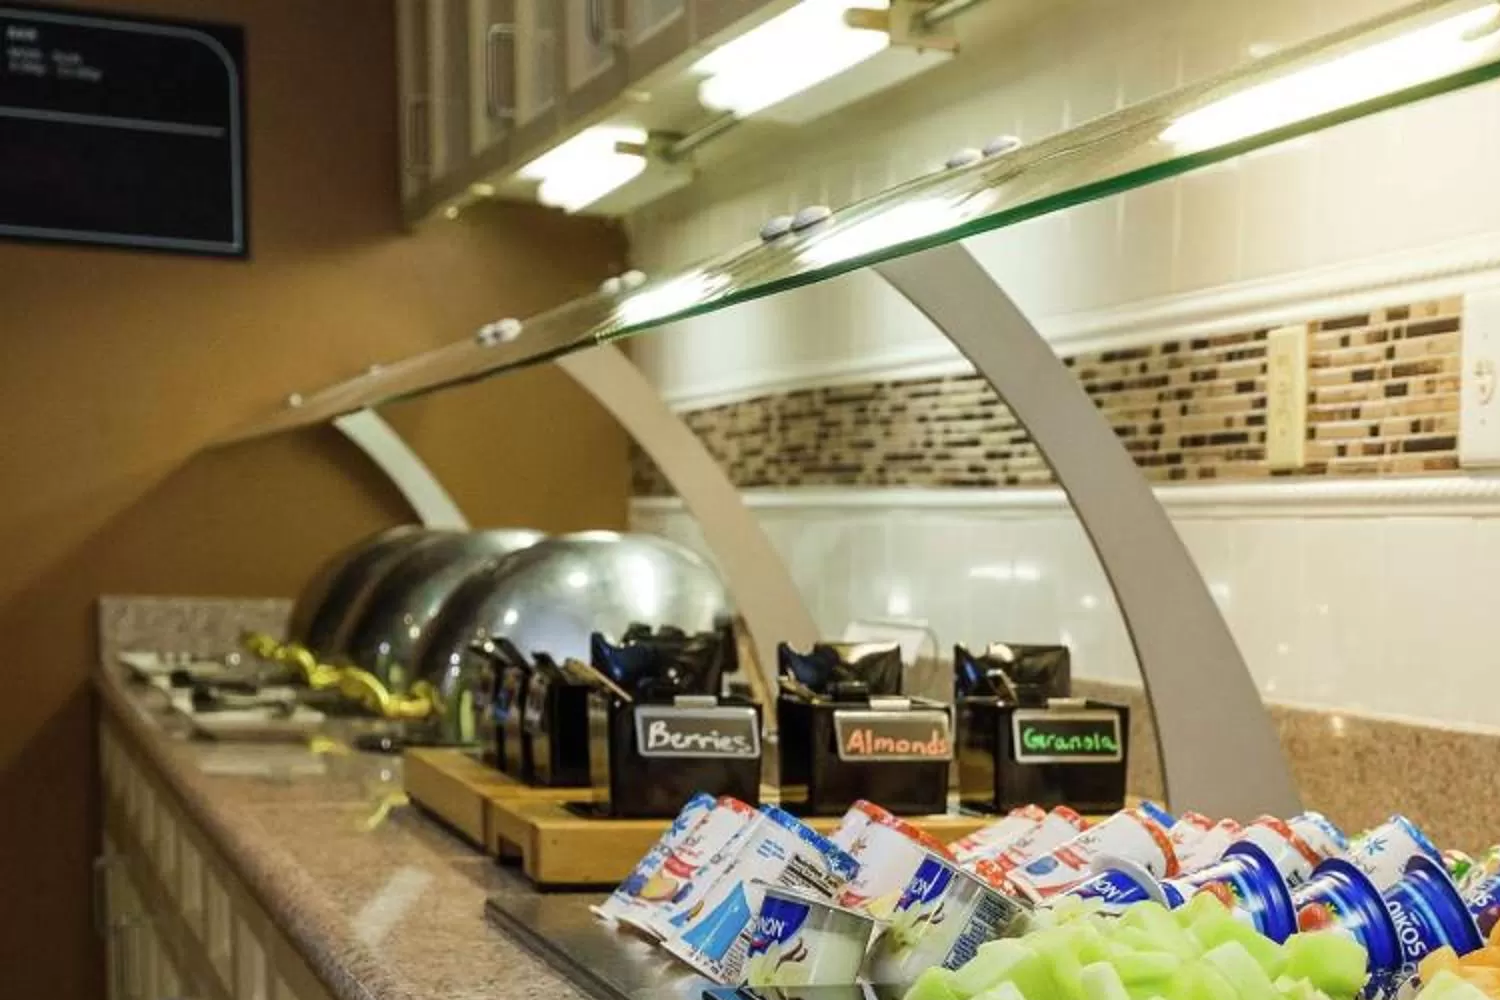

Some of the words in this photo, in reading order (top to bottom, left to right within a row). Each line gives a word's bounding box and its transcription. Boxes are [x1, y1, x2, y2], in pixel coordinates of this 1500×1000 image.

[648, 720, 752, 753] Berries
[847, 729, 947, 755] Almonds
[1023, 727, 1119, 752] Granola
